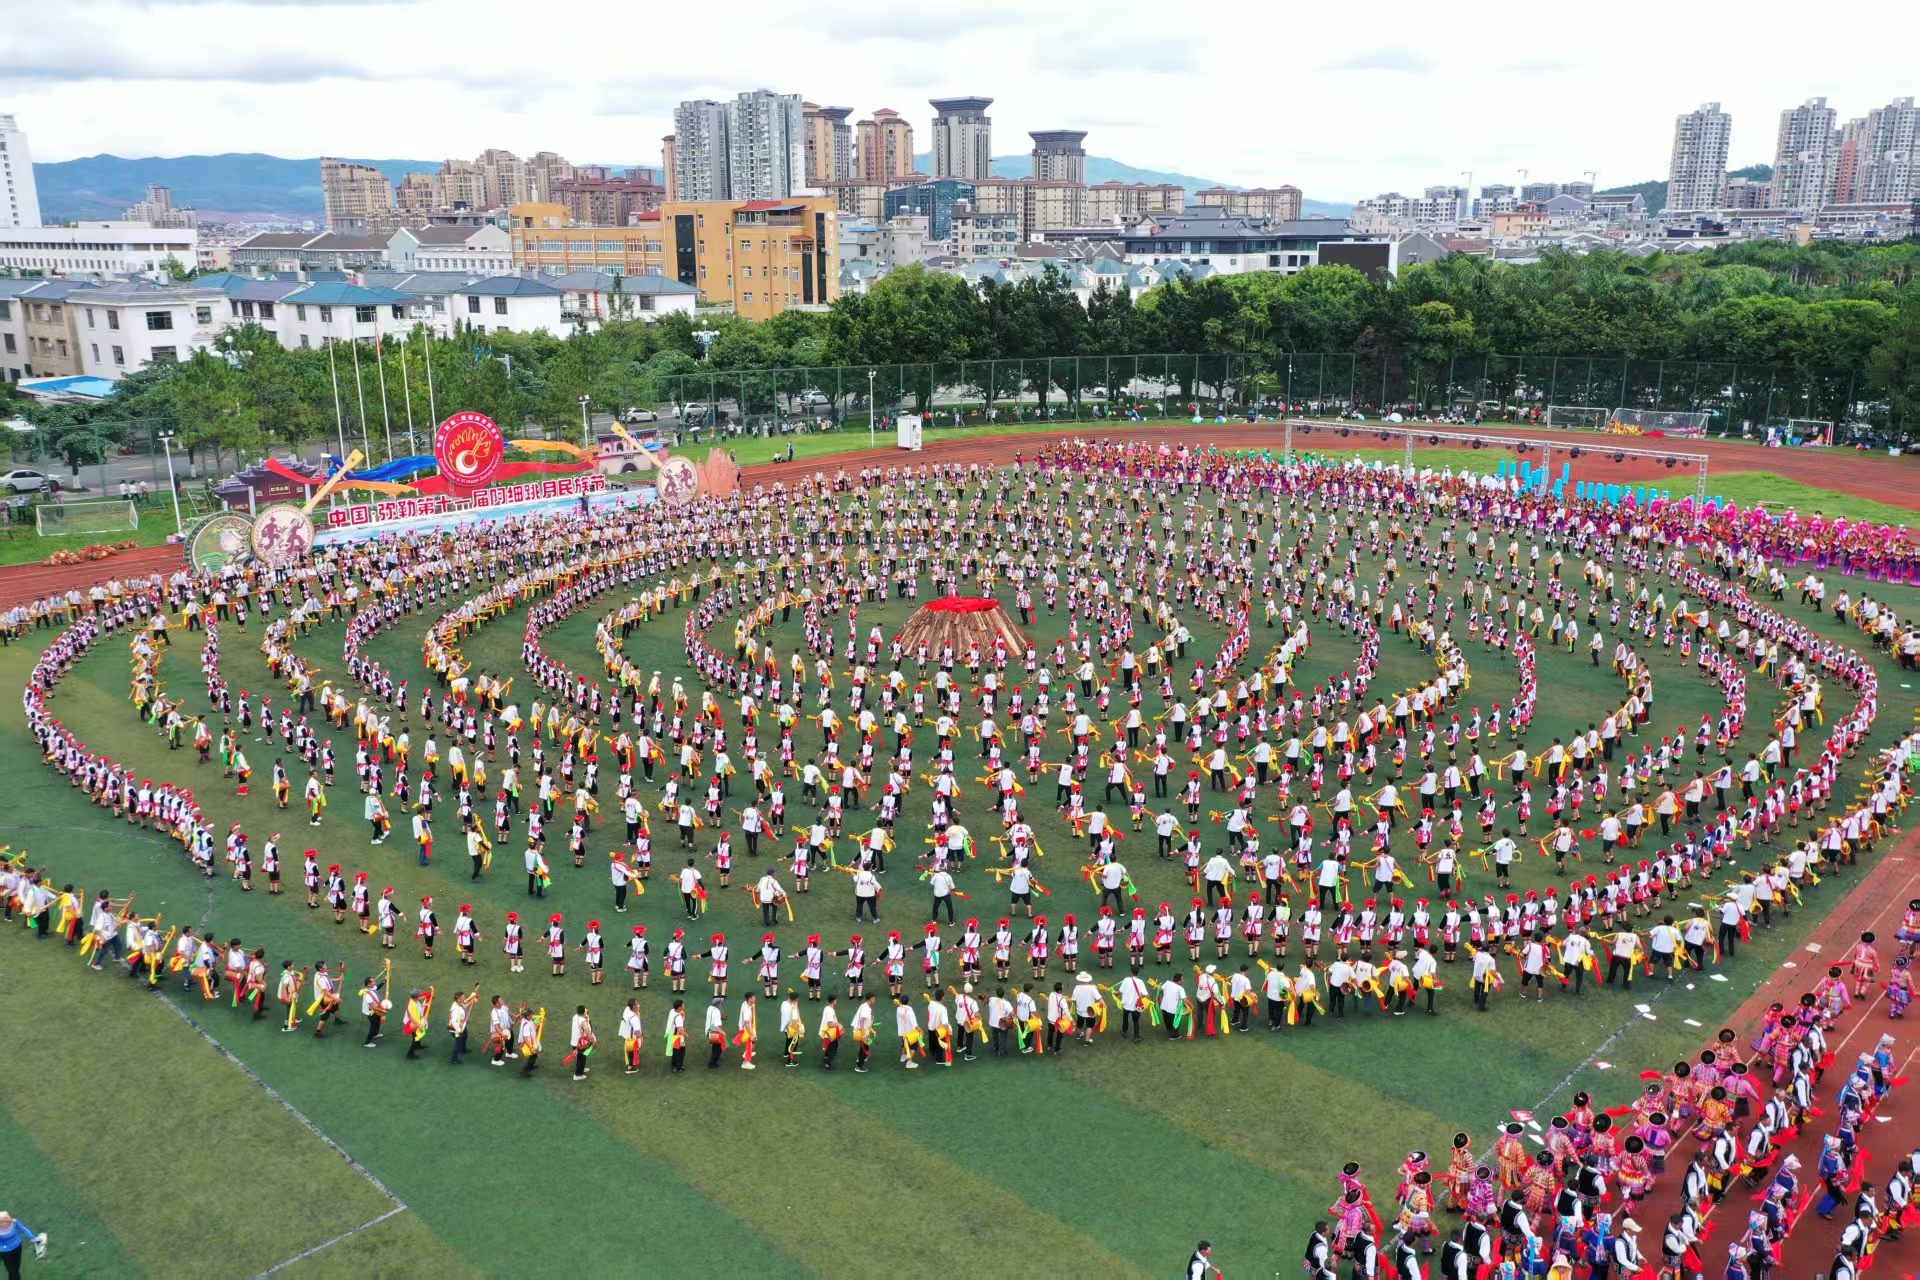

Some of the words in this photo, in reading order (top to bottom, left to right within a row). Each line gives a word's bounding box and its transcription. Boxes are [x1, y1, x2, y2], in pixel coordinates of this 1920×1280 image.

[328, 474, 606, 528] 中国·弥勒第十一届阿细跳月民族节
